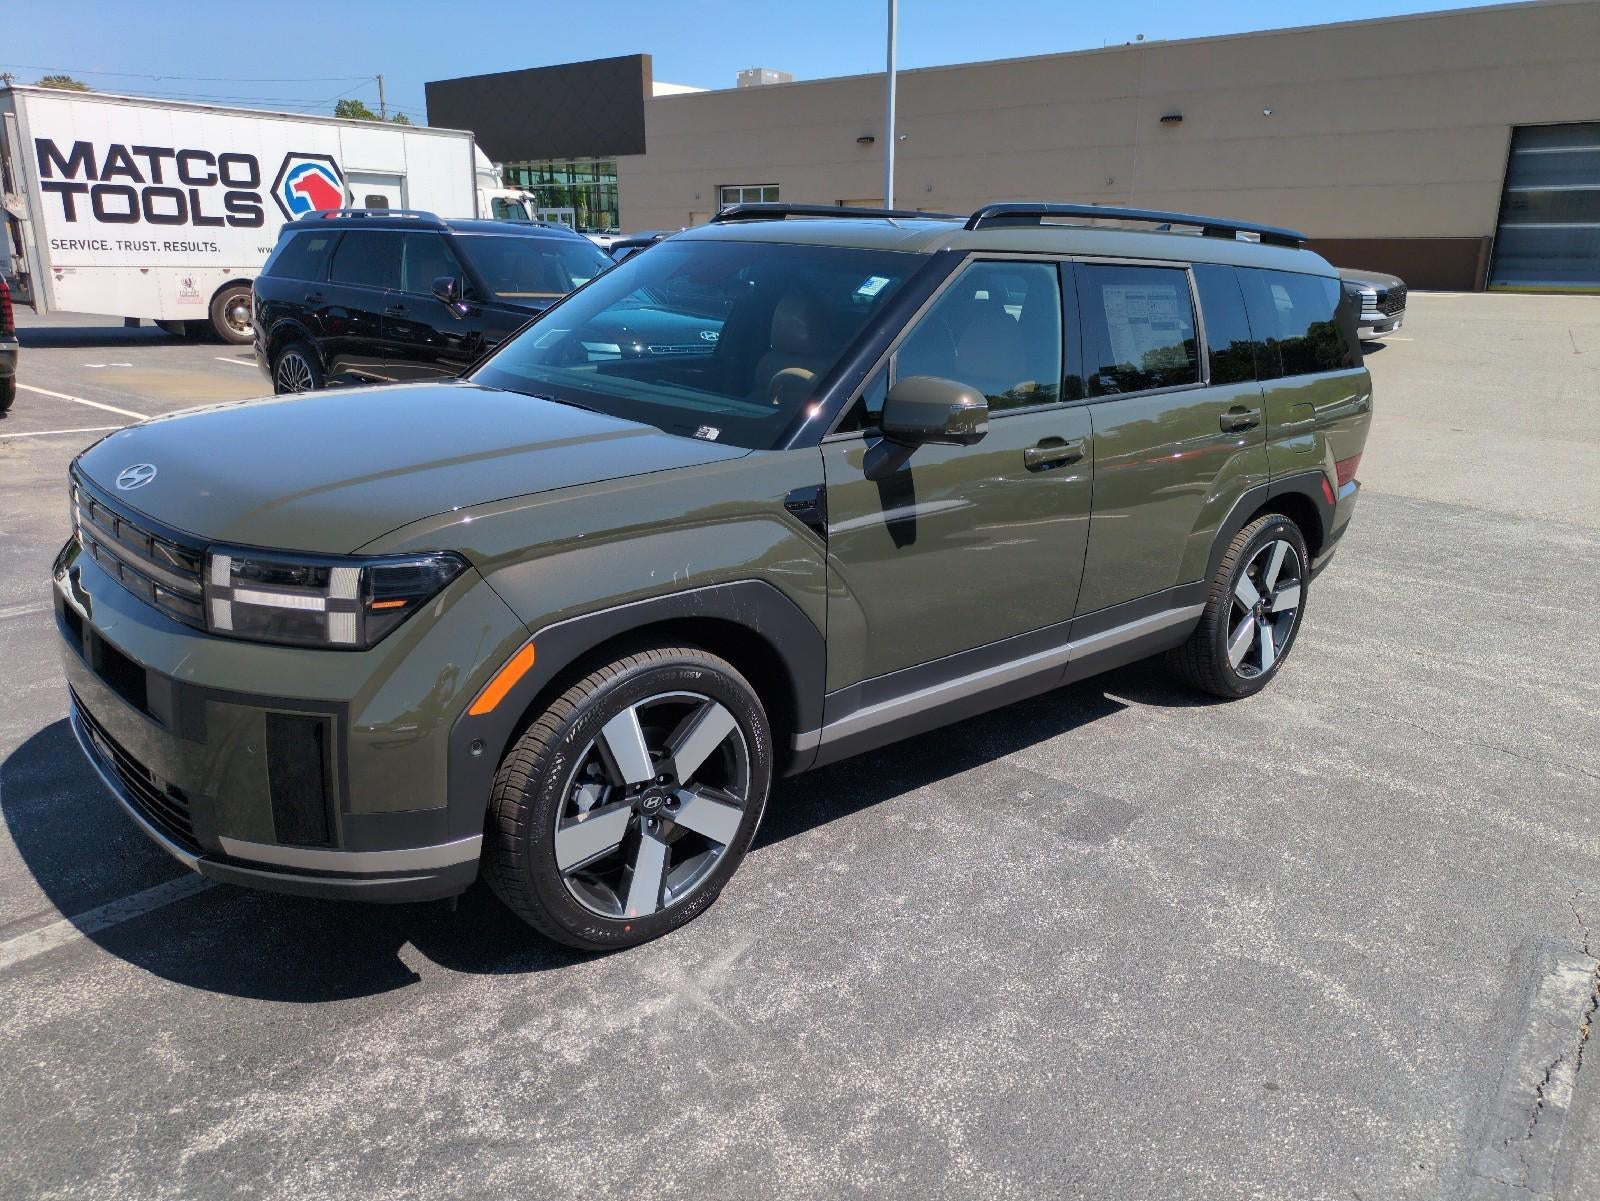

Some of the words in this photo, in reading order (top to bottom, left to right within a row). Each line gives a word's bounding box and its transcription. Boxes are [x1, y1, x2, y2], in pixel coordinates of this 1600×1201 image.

[35, 138, 261, 190] MATCO
[41, 181, 265, 228] TOOLS
[51, 239, 113, 251] SERVICE.
[116, 240, 161, 252] TRUST.
[163, 241, 221, 253] RESULTS.
